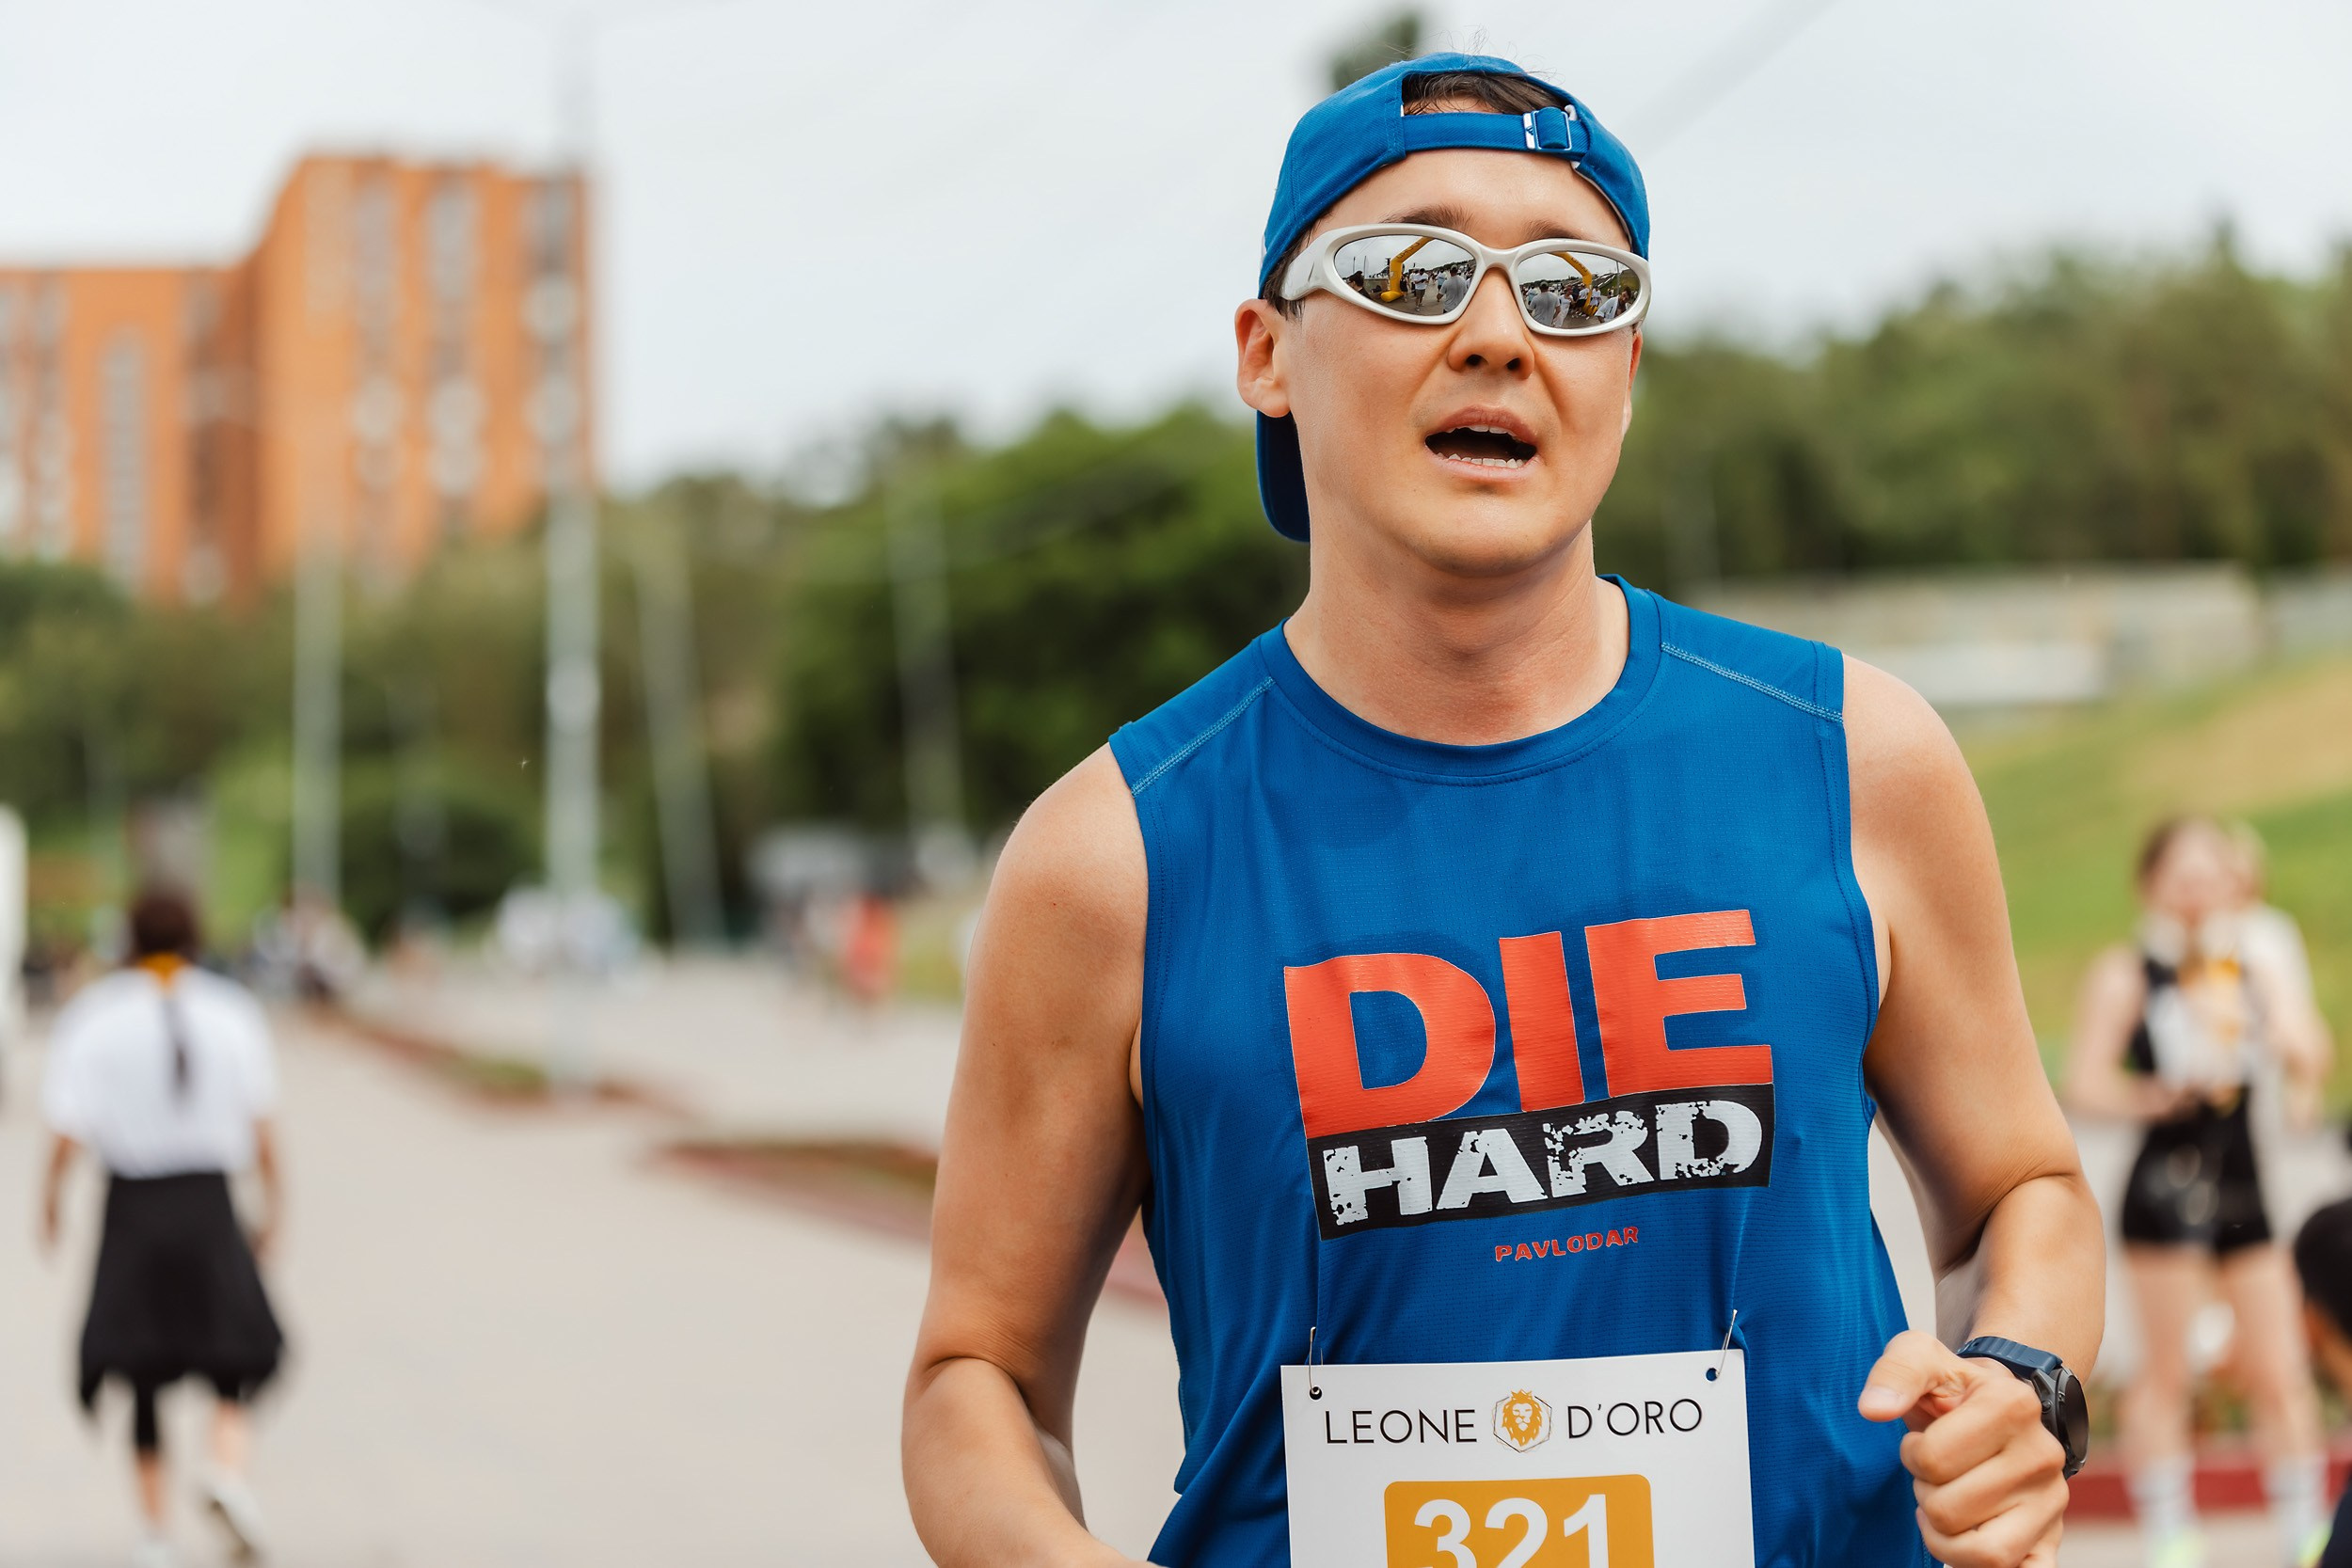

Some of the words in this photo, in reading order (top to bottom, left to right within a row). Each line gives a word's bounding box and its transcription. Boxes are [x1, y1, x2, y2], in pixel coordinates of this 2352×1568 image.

[1283, 909, 1773, 1138] DIE
[1323, 1099, 1763, 1225] HARD
[1494, 1226, 1639, 1262] PAVLODAR
[1325, 1408, 1478, 1445] LEONE
[1567, 1398, 1703, 1440] D'ORO
[1413, 1494, 1608, 1568] 321
